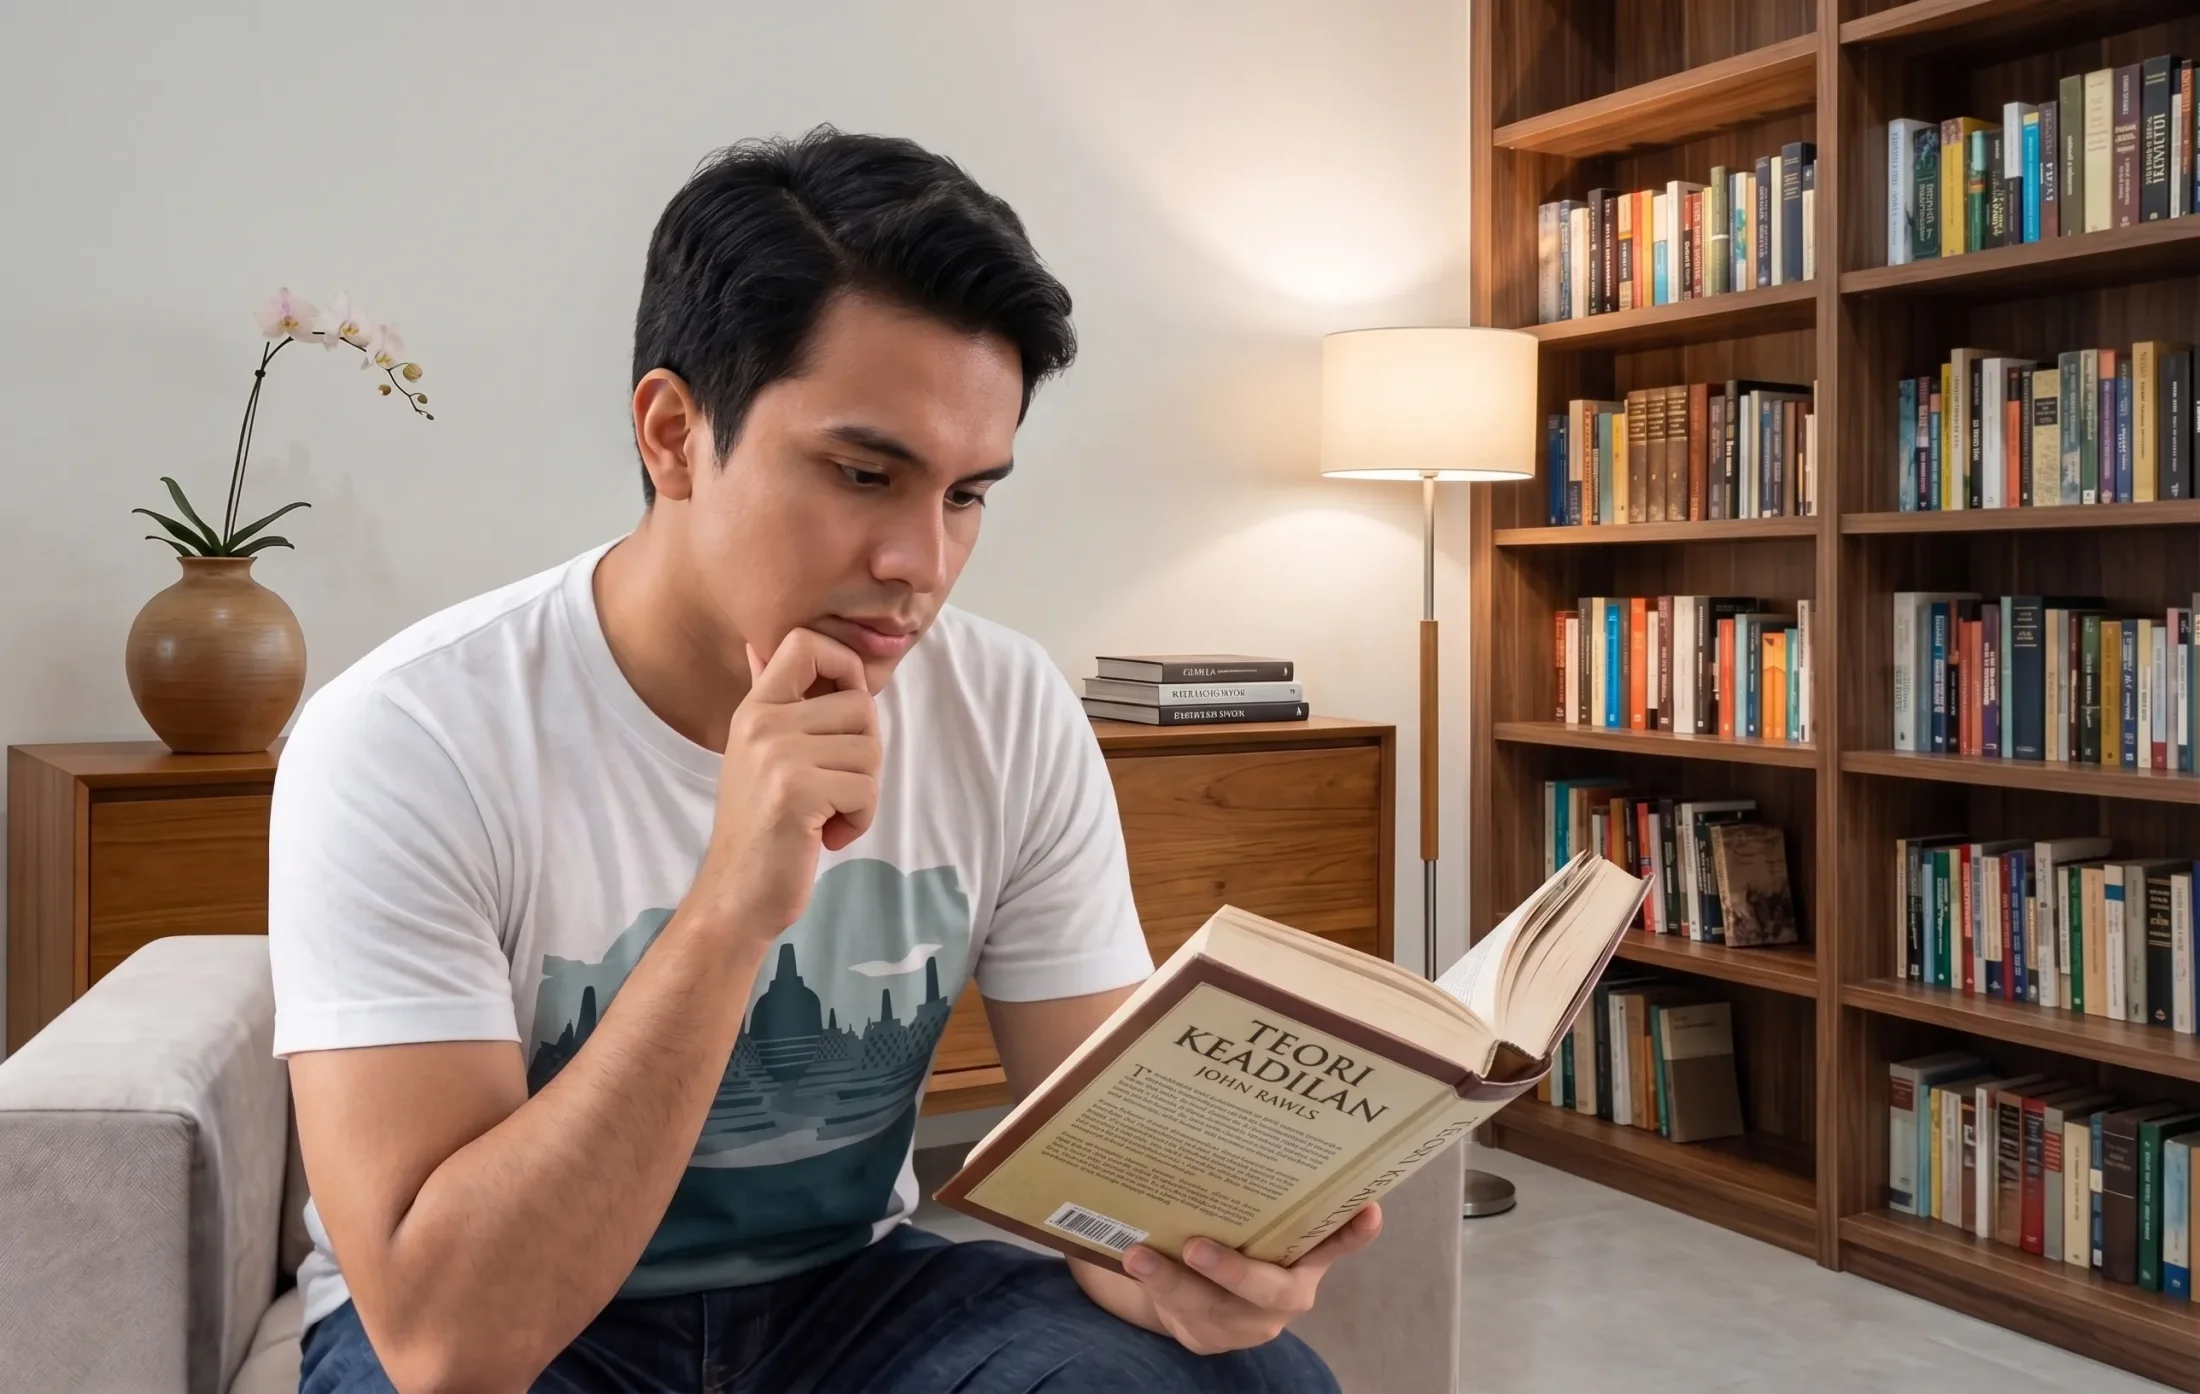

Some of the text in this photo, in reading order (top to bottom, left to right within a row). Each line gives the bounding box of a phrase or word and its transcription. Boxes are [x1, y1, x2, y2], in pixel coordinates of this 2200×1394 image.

[1173, 1025, 1391, 1124] KEADILAN
[1245, 1019, 1376, 1087] TEORI
[1194, 1066, 1320, 1120] JOHN RAWLS
[1397, 1115, 1480, 1166] TEORI
